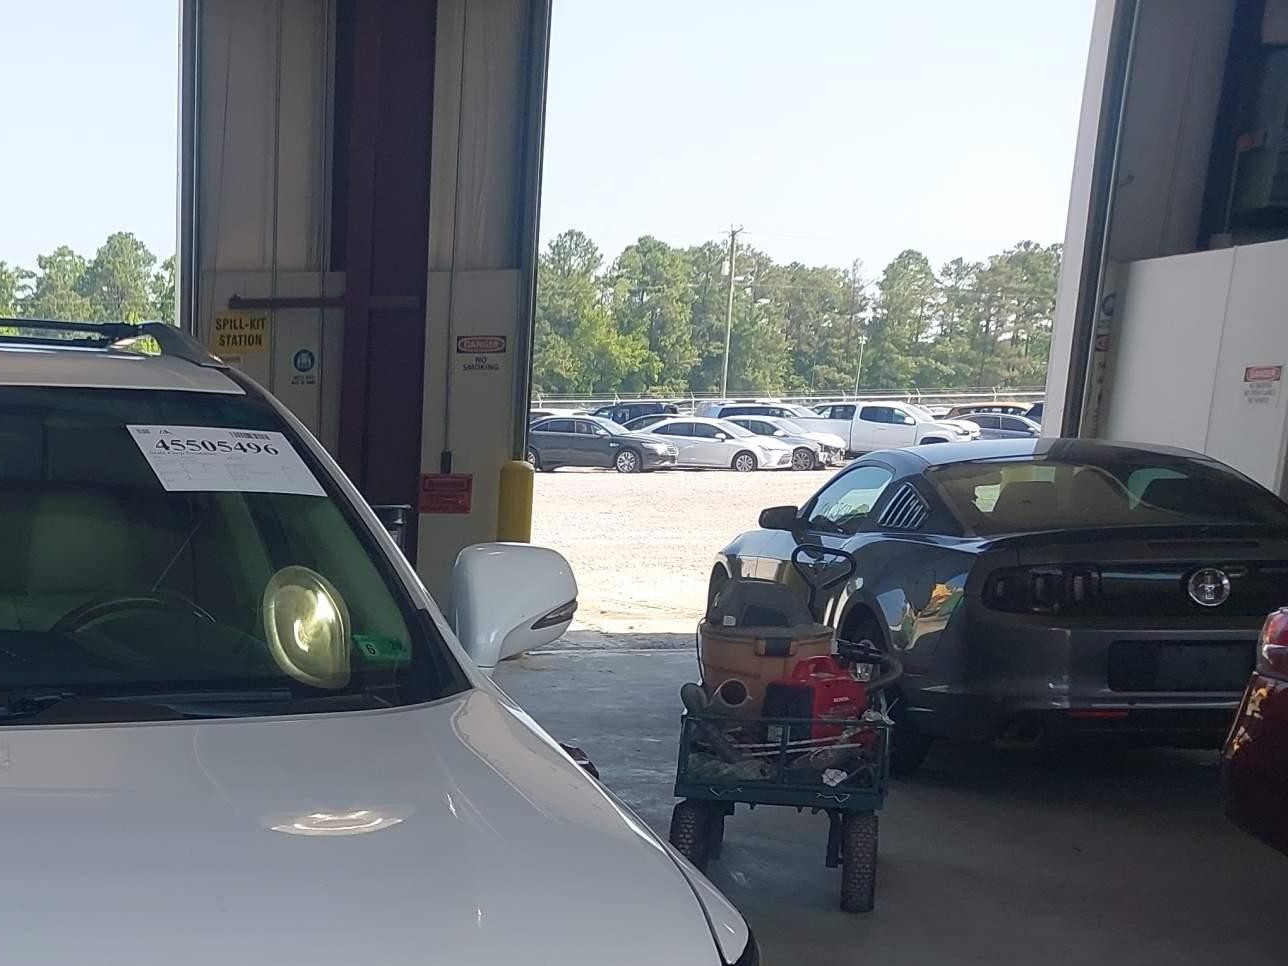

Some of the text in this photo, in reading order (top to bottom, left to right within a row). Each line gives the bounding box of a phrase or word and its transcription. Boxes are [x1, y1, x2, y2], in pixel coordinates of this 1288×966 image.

[215, 317, 266, 331] SPILL-KIT
[218, 334, 263, 347] STATION
[463, 340, 499, 349] DANGER
[475, 356, 488, 364] NO
[155, 438, 279, 457] 45505496
